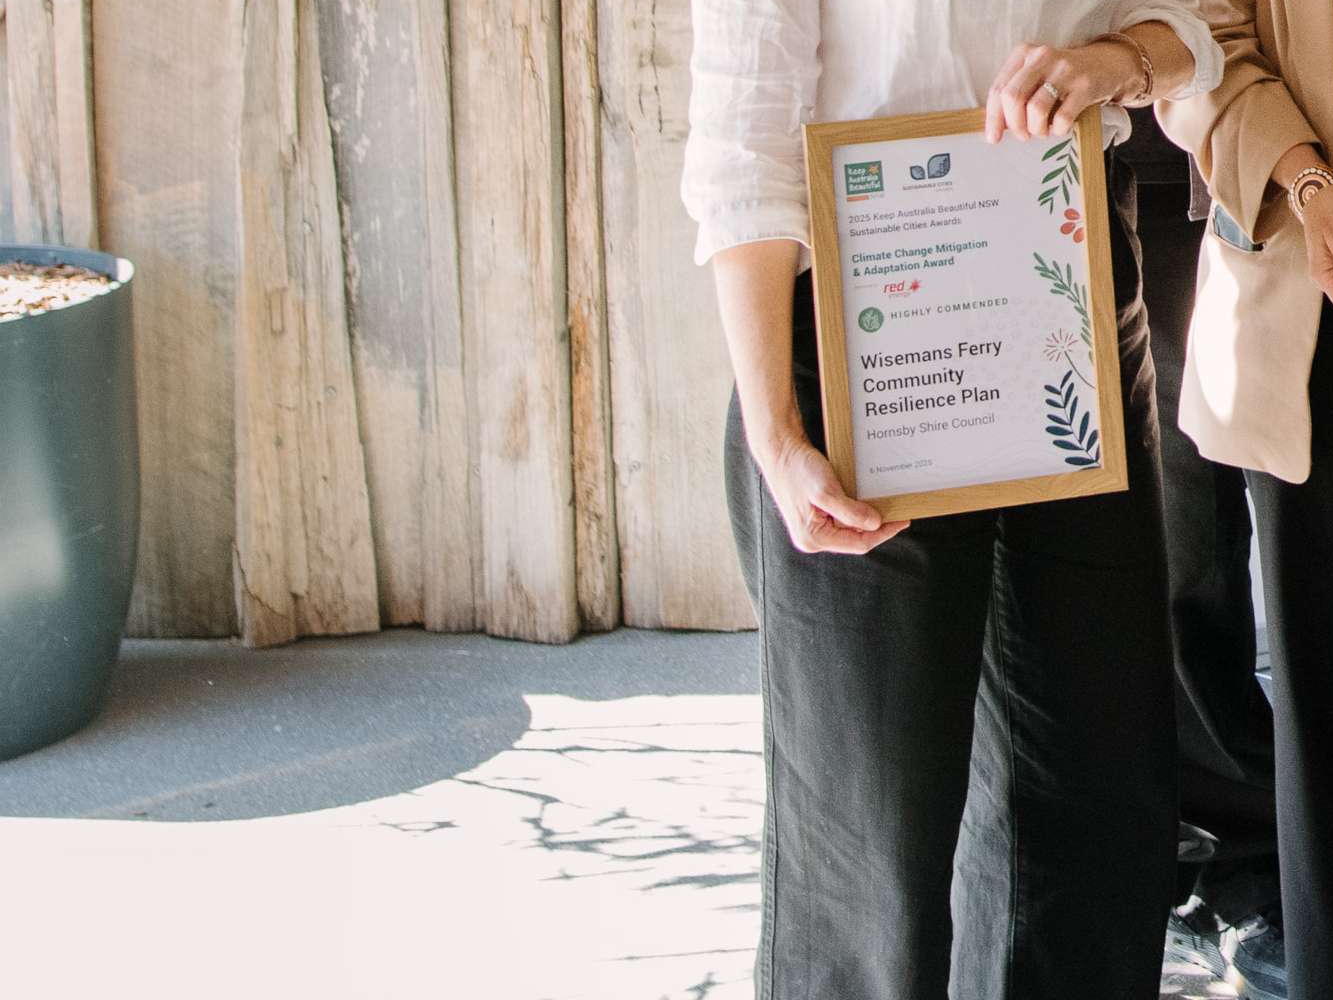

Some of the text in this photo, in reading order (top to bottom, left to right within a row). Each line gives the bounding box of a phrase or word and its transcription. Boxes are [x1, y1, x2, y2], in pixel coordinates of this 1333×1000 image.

[849, 182, 880, 191] Beautiful
[849, 199, 999, 223] 2025 Keep Australia Beautiful NSW
[850, 218, 962, 237] Sustainable Cities Awards
[852, 240, 988, 263] Climate Change Mitigation
[853, 256, 954, 277] & Adaptation Award
[884, 281, 905, 293] red
[889, 291, 910, 299] energy
[890, 298, 1008, 319] HIGHLY COMMENDED
[861, 341, 1002, 370] Wisemans Ferry
[863, 368, 964, 393] Community
[865, 387, 1000, 417] Resilience Plan
[867, 413, 995, 440] Hornsby Shire Council
[876, 462, 913, 473] November
[914, 459, 933, 468] 2025
